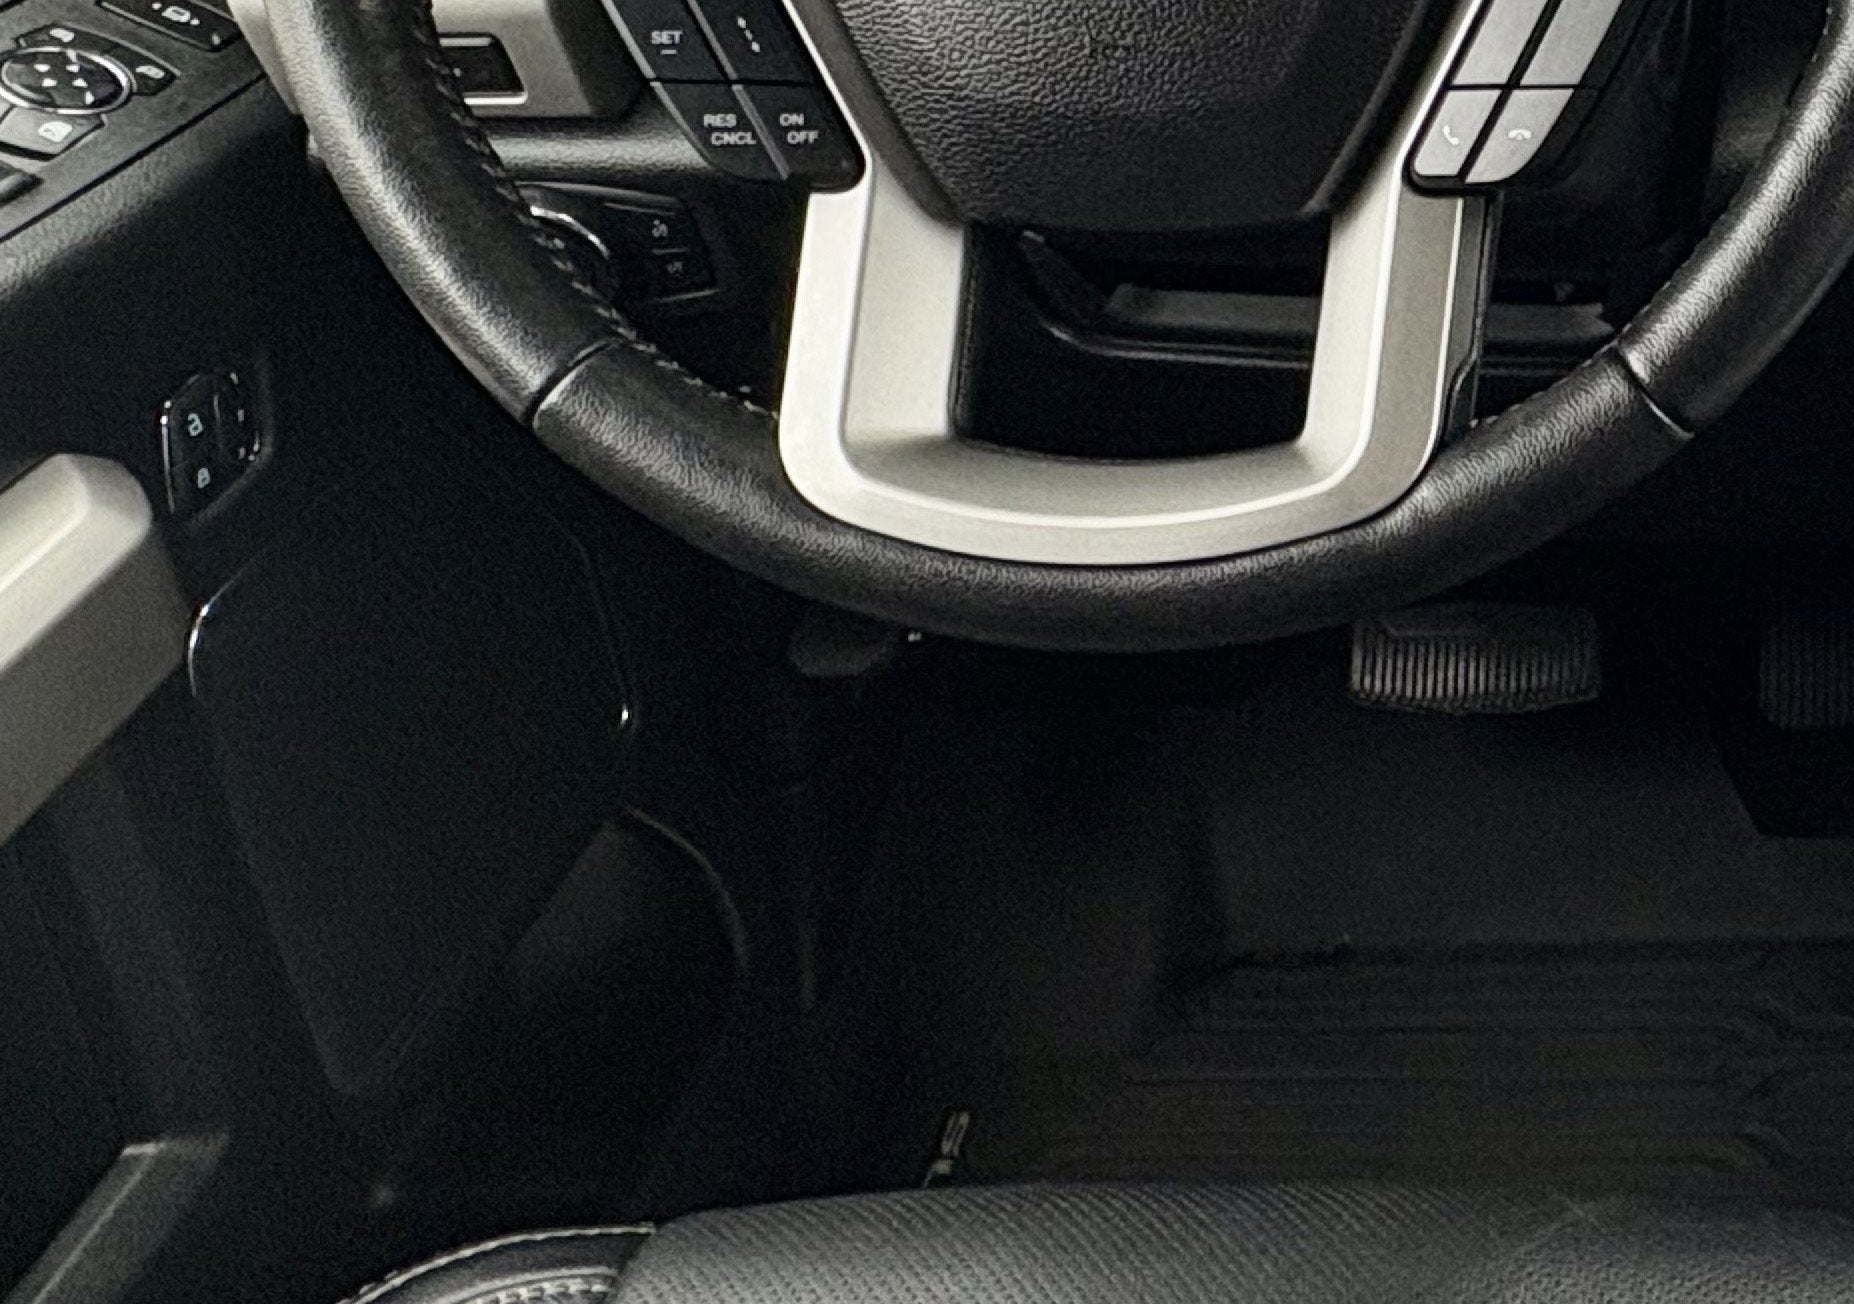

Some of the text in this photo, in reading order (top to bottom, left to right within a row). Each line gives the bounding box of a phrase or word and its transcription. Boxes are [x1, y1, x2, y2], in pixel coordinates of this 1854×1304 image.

[651, 30, 683, 44] SET
[703, 113, 737, 127] RES
[779, 113, 805, 126] ON
[711, 132, 756, 145] CNCL
[787, 131, 819, 144] OFF
